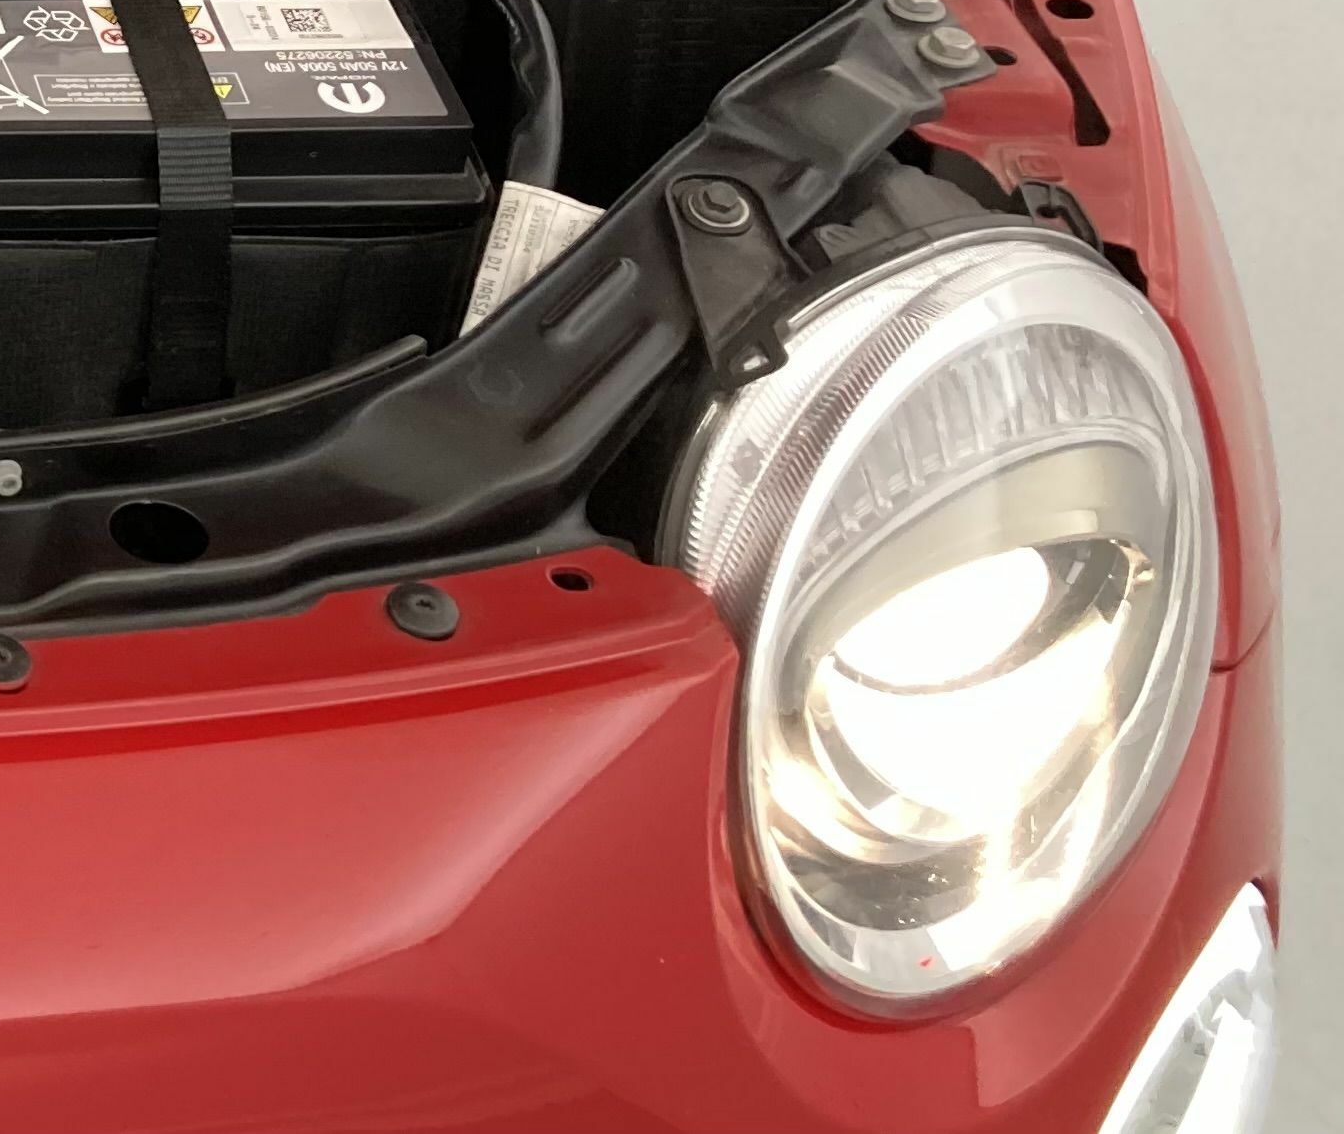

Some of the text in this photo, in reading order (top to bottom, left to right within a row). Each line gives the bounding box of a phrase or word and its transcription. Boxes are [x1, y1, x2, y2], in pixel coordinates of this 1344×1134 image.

[276, 50, 354, 60] 52206275
[264, 60, 408, 73] 12V 50Ah 500A (EN)
[470, 199, 520, 316] TRECCIA DI MASSA
